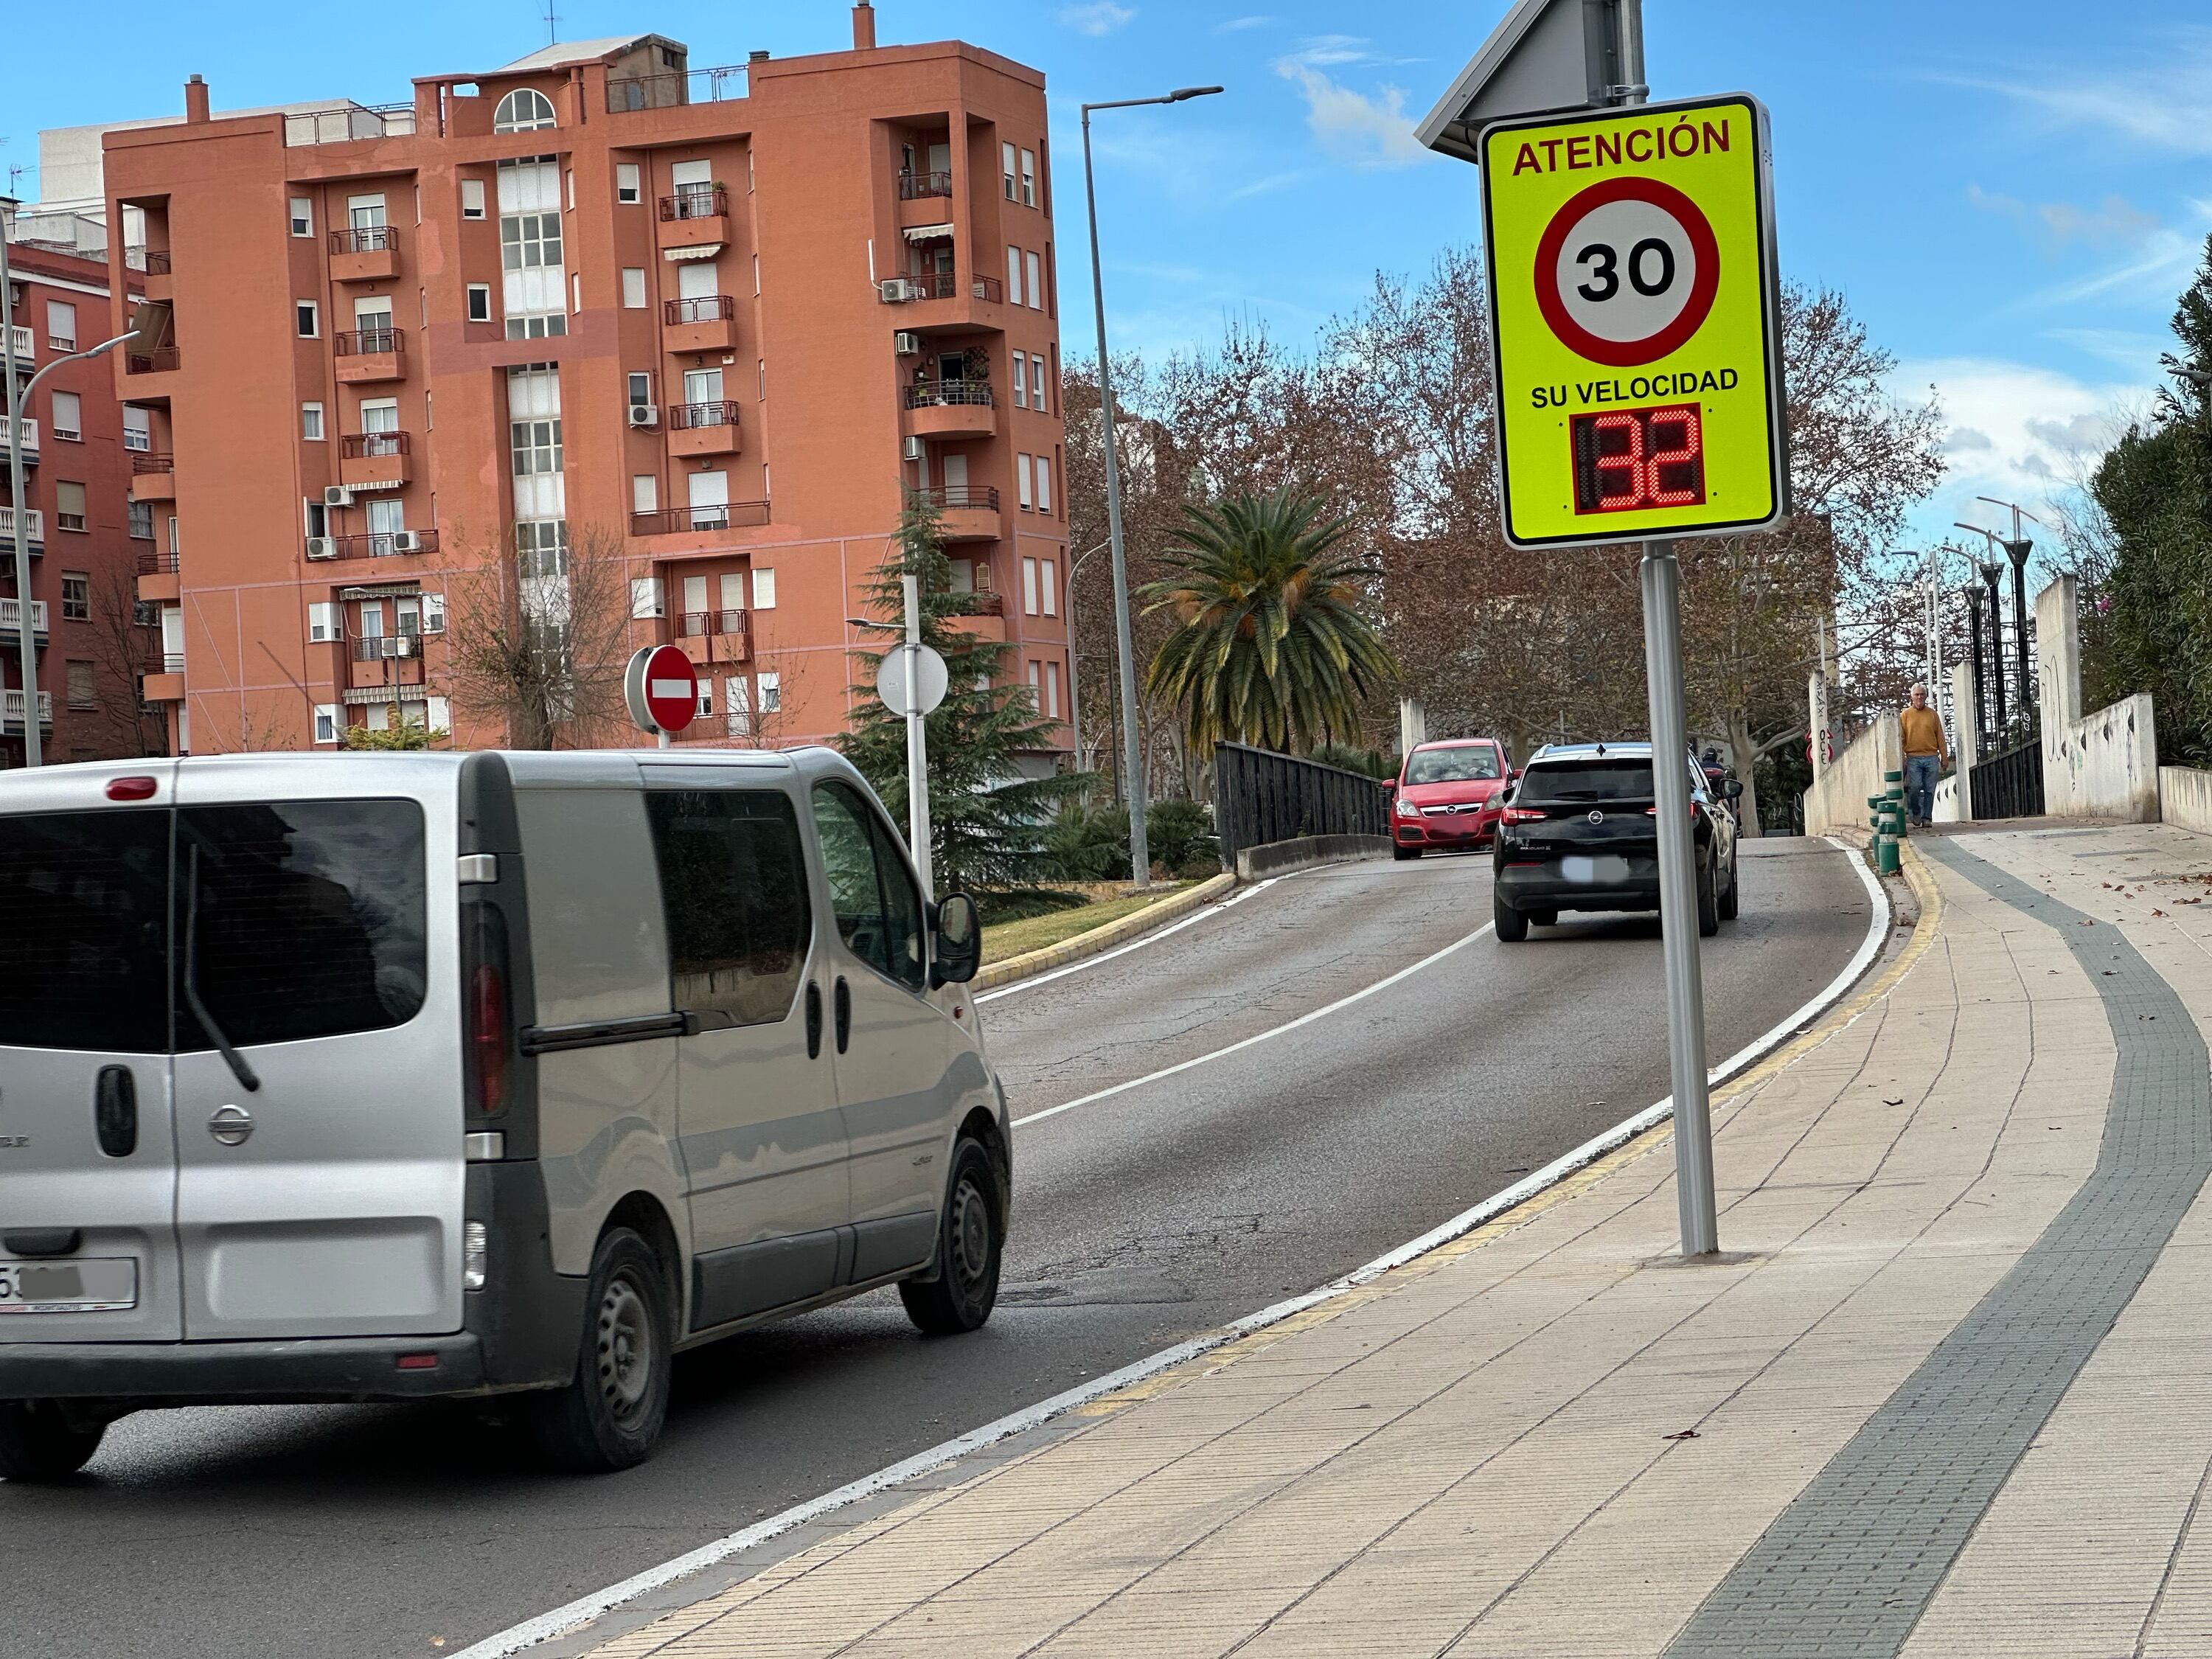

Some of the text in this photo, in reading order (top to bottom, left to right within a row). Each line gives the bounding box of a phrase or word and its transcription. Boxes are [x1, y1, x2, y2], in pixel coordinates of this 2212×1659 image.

[1512, 115, 1730, 176] ATENCIÓN
[1576, 237, 1675, 302] 30
[1531, 368, 1739, 408] SU VELOCIDAD
[1594, 409, 1699, 508] 32
